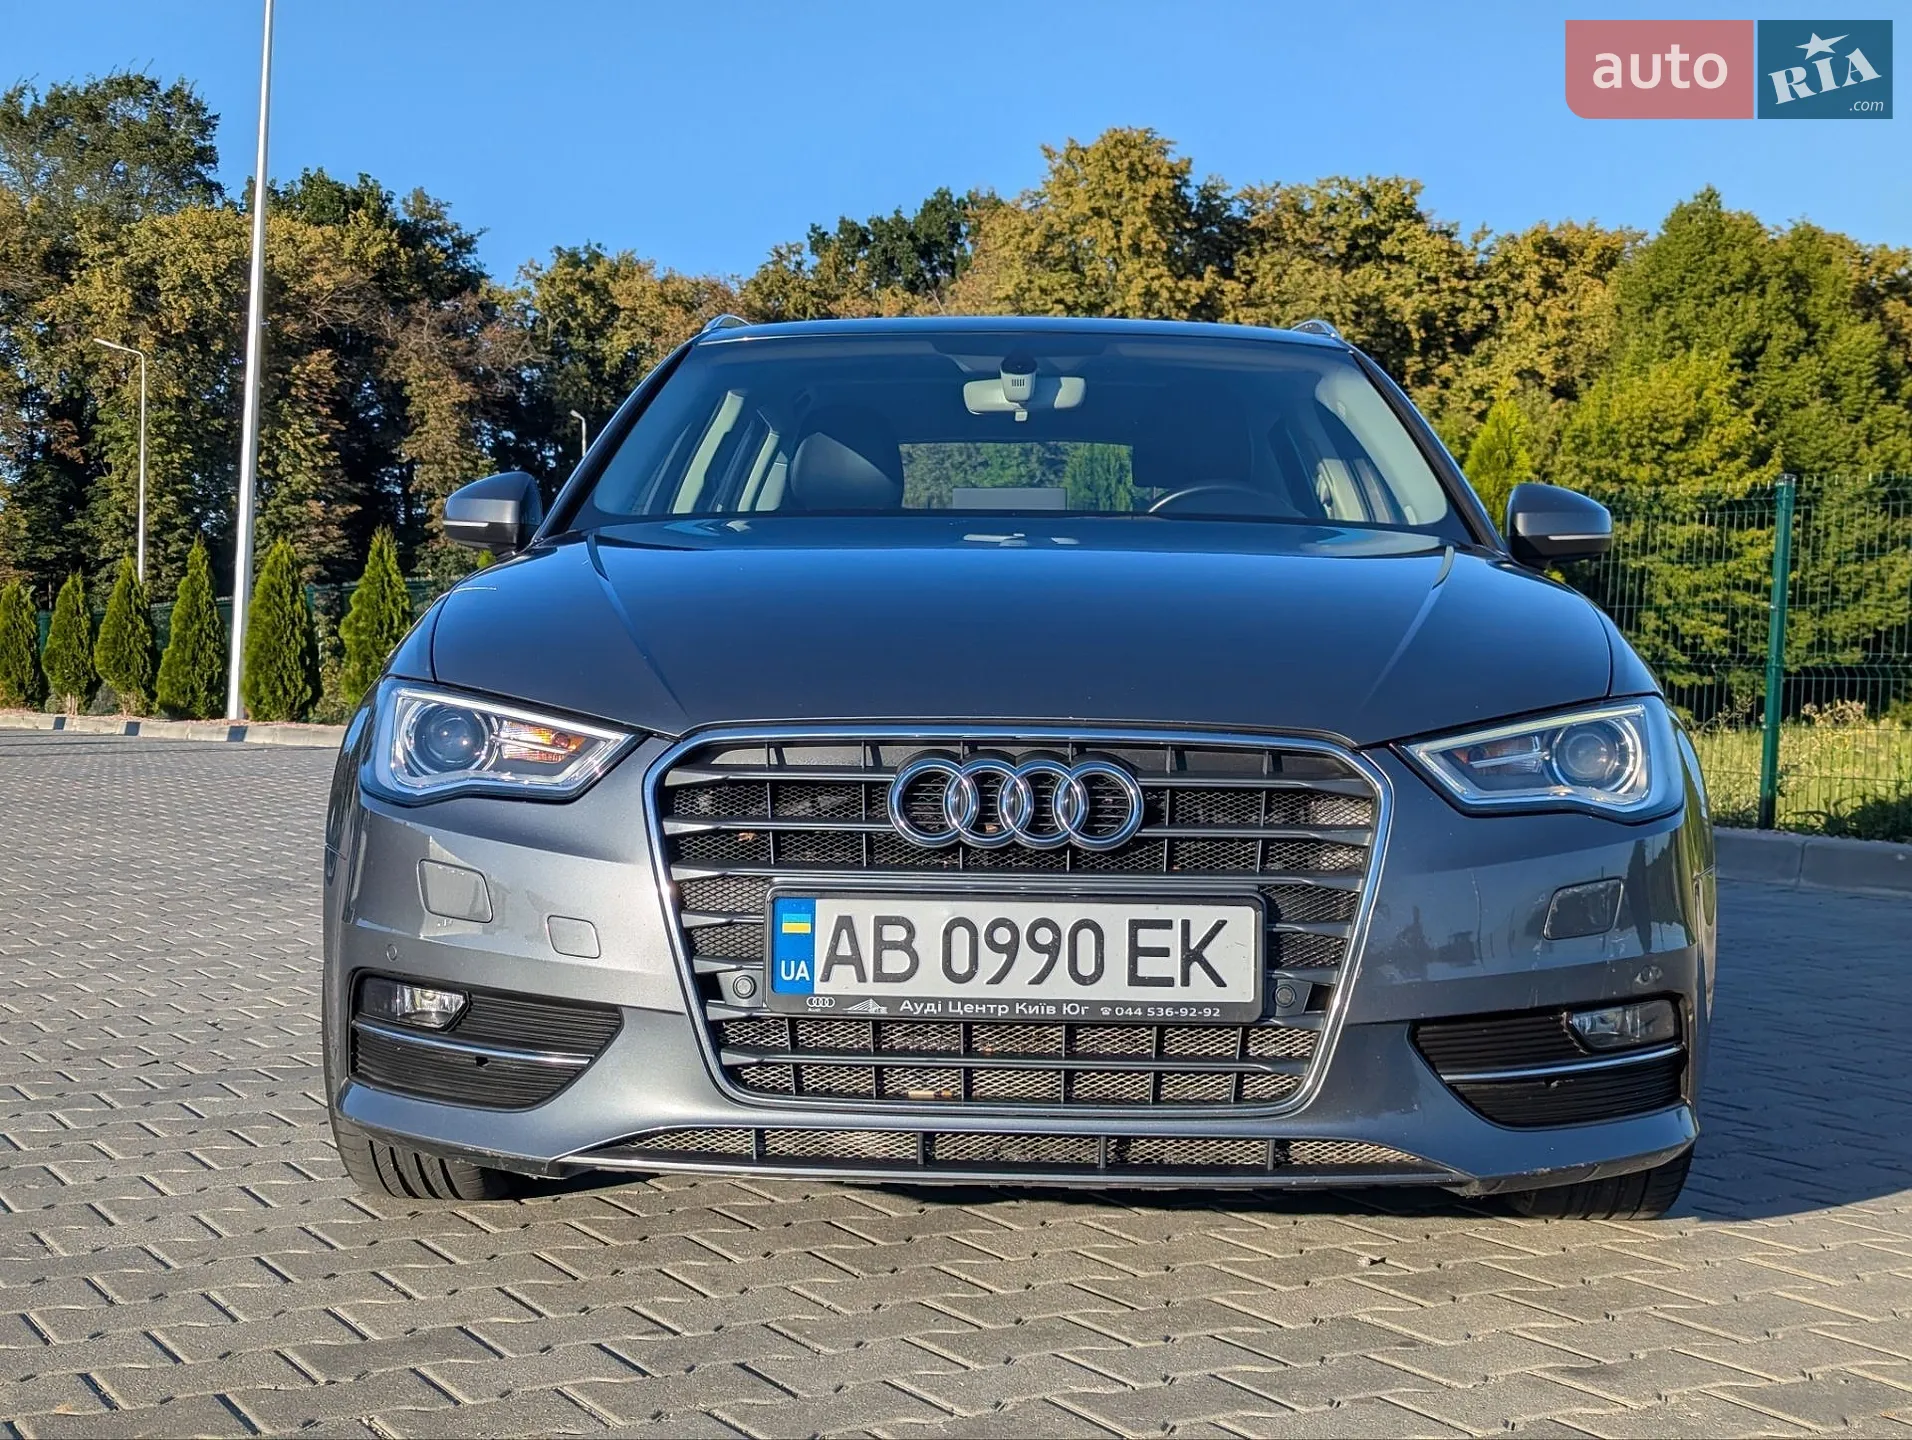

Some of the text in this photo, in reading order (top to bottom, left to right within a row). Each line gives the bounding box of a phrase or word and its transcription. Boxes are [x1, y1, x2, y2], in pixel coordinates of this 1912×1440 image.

[819, 915, 1228, 987] AB 0990 EK
[780, 961, 810, 981] UA
[900, 1000, 1220, 1017] Ауді Центр Київ Юг 044 536-92-92
